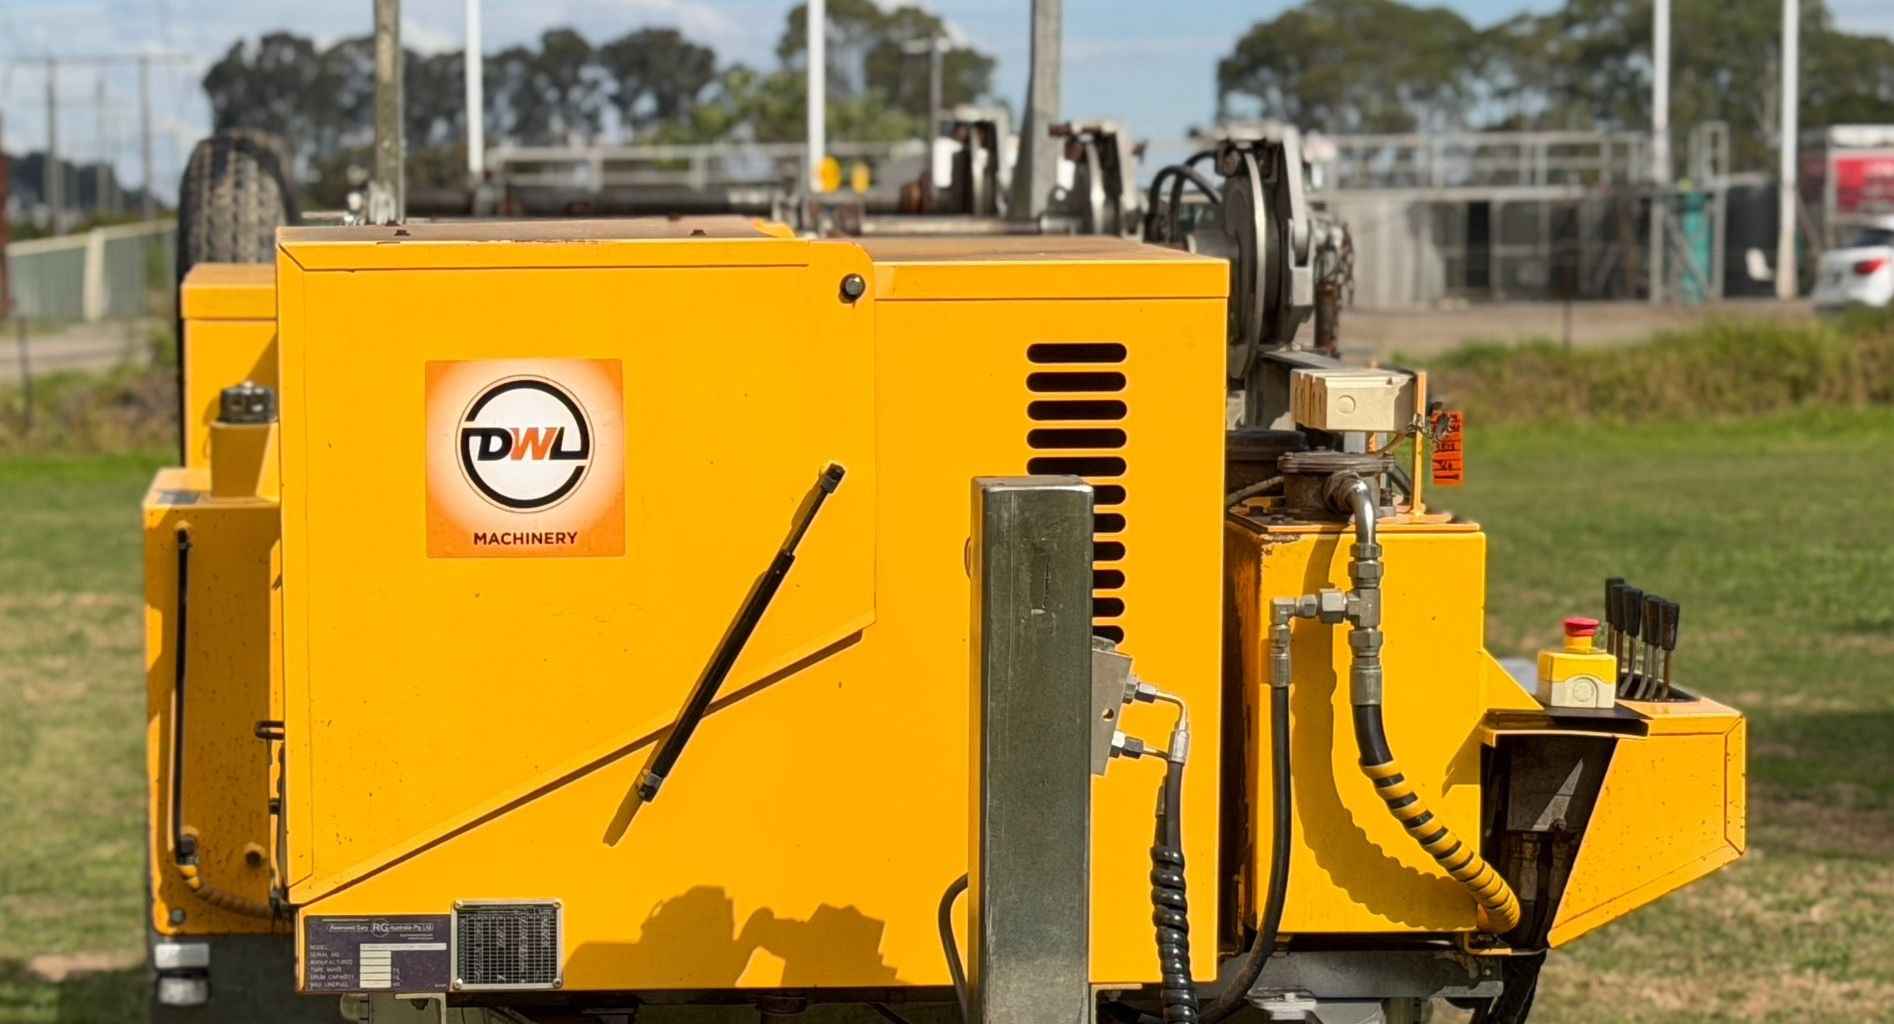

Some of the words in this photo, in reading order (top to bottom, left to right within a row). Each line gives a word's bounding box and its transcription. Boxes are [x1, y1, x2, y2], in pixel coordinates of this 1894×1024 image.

[461, 427, 589, 461] DWL
[473, 531, 578, 546] MACHINERY
[372, 923, 389, 932] RG
